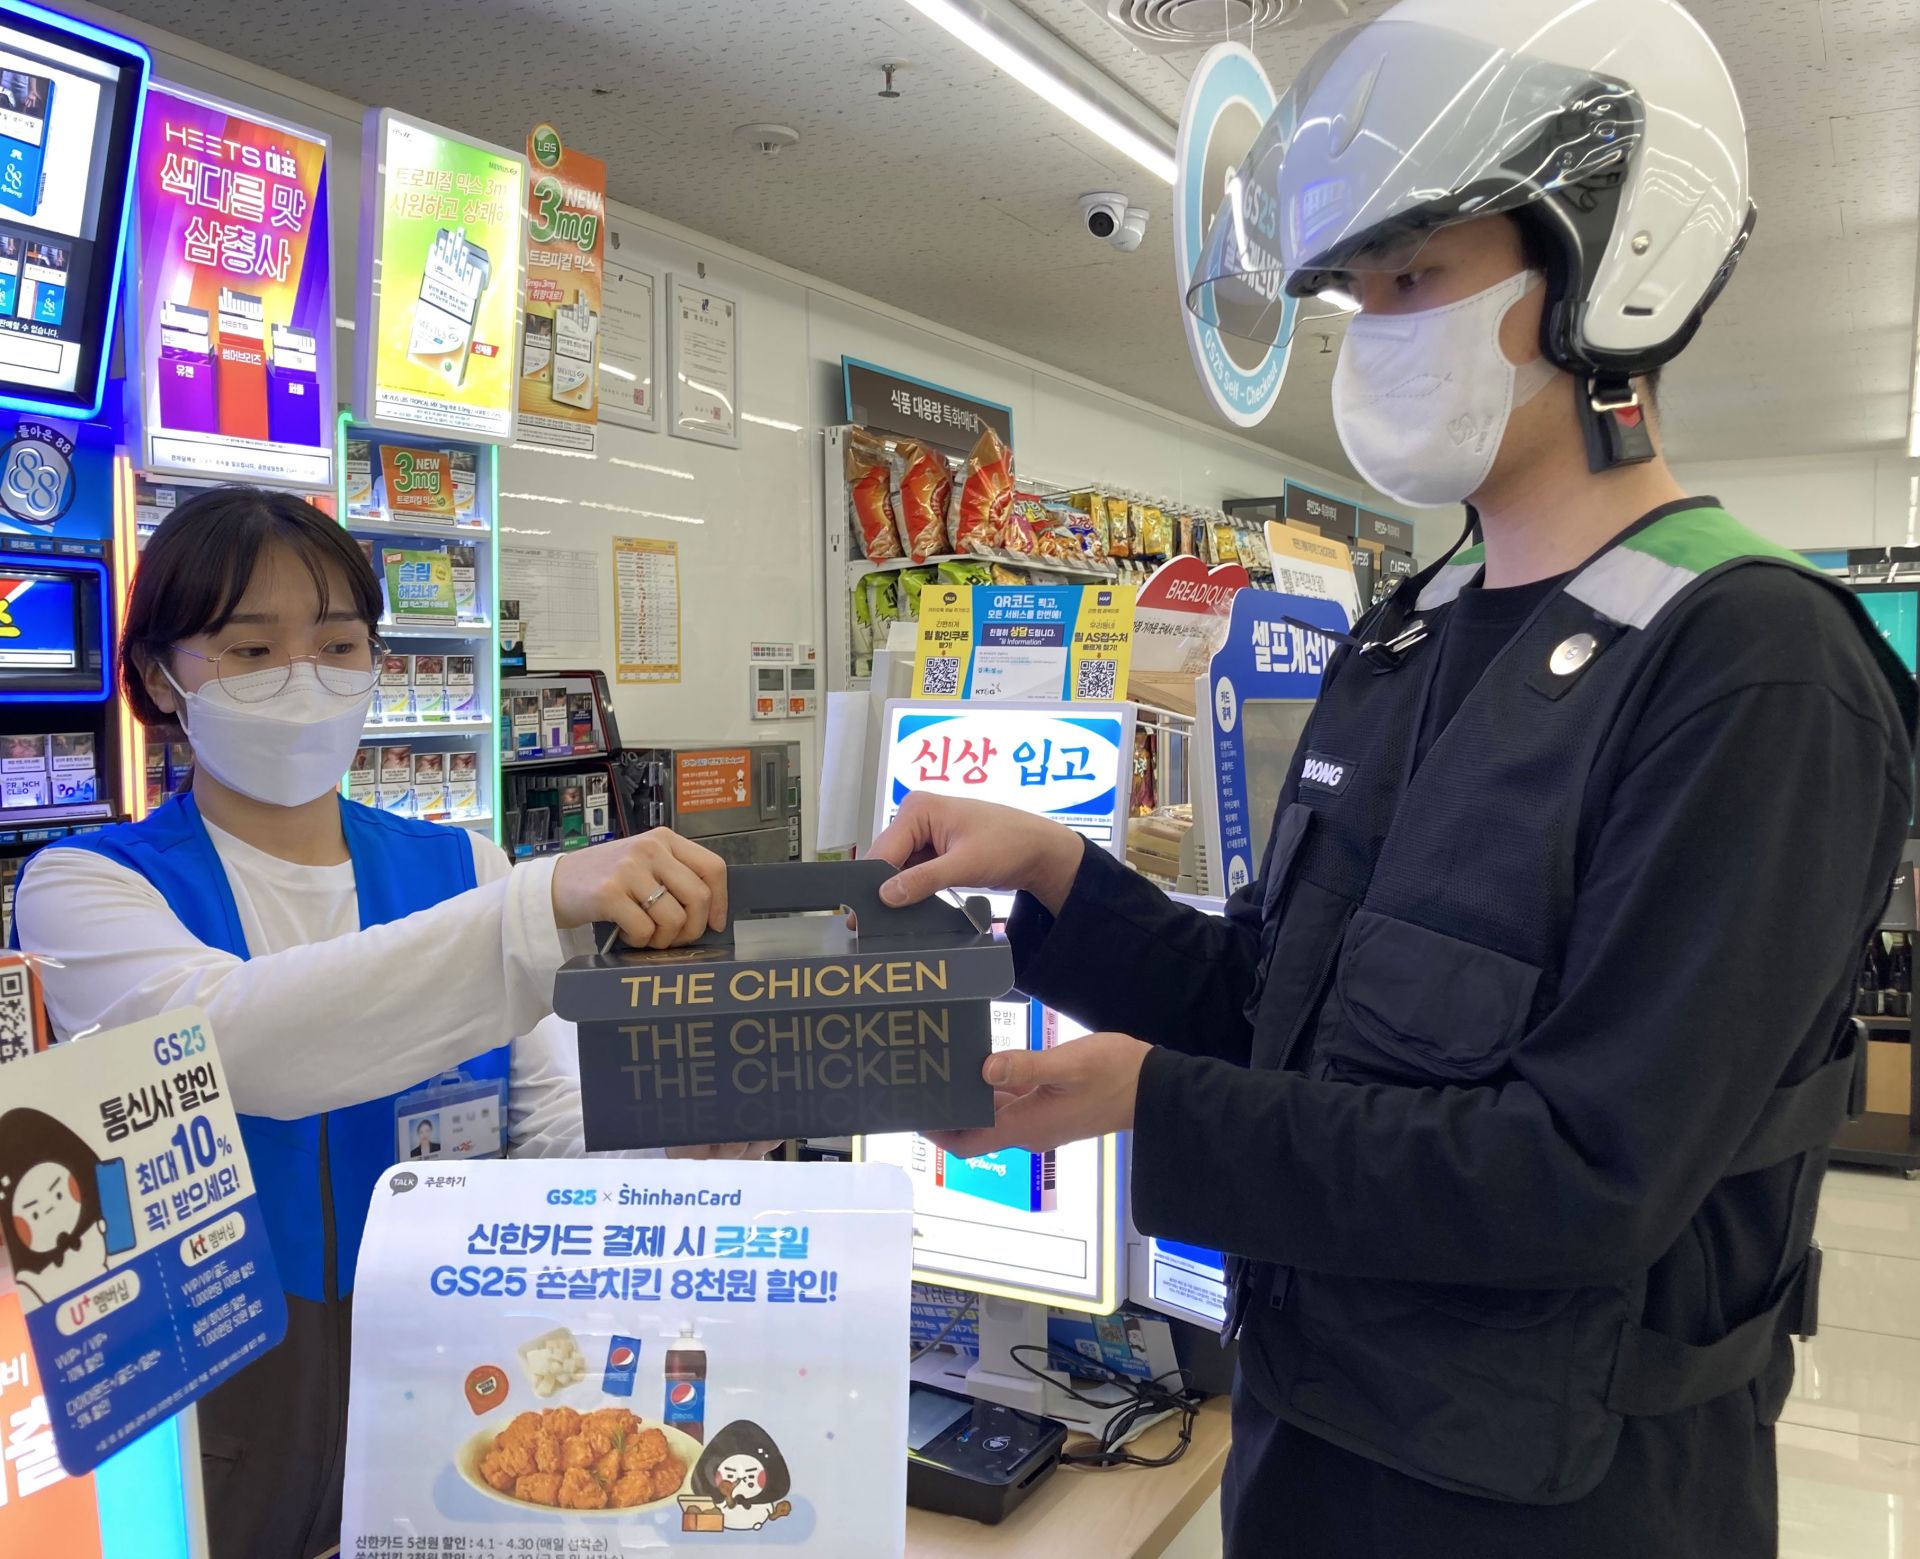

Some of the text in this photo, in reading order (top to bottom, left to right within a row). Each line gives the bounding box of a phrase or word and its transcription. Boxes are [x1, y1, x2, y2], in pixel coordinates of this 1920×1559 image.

[165, 122, 297, 179] HEETS 대표
[537, 141, 557, 153] LBS
[160, 153, 307, 232] 색다른 맛
[396, 166, 453, 193] 트로피컬
[456, 173, 482, 195] 믹스
[390, 191, 460, 221] 시원하고
[528, 175, 598, 252] 3mg
[565, 188, 602, 212] NEW
[184, 216, 291, 282] 삼총사
[528, 249, 597, 273] 트로피컬 믹스
[21, 323, 29, 332] 수
[1204, 329, 1225, 381] GS25
[1223, 370, 1240, 401] Self
[1246, 359, 1278, 406] Checkout
[890, 389, 979, 434] 식품 대용량 특화매대
[18, 424, 71, 454] 돌아온 88
[393, 451, 441, 496] 3mg
[416, 458, 440, 471] NEW
[396, 495, 436, 505] 트로피컬 믹스
[399, 561, 432, 583] 슬림
[398, 583, 440, 599] 해졌네?
[993, 594, 1058, 609] QR코드 찍고,
[935, 620, 960, 628] 간편하게
[987, 609, 1063, 620] 모든 서비스를 한번에!
[934, 630, 970, 641] 할인쿠폰
[989, 628, 1009, 637] 친절히
[1084, 632, 1129, 643] AS접수처
[1220, 690, 1231, 704] 카드
[911, 735, 1097, 787] 신상 입고
[6, 780, 41, 790] FRNCH
[620, 958, 948, 1007] THE CHICKEN
[152, 1024, 206, 1066] GS25
[618, 1008, 950, 1062] THE CHICKEN
[620, 1047, 952, 1100] THE CHICKEN
[98, 1061, 220, 1143] 통신사 할인
[135, 1114, 234, 1196] 최대 10%
[392, 1175, 467, 1188] TALK 주문하기
[143, 1164, 241, 1232] 꼭! 받으세요!
[546, 1189, 597, 1206] GS25
[189, 1220, 237, 1260] kt 멤버십
[467, 1222, 811, 1261] 신한카드 결제 시 금토일
[92, 1279, 132, 1315] 멤버십
[430, 1264, 839, 1304] GS25 쏜살치킨 8천원 할인!
[354, 1536, 405, 1551] 신한카드
[407, 1536, 439, 1550] 5천원
[441, 1536, 467, 1551] 할인
[476, 1537, 495, 1550] 4.1
[505, 1537, 534, 1550] 4.30
[535, 1536, 565, 1552] (매일
[567, 1536, 609, 1552] 선착순)
